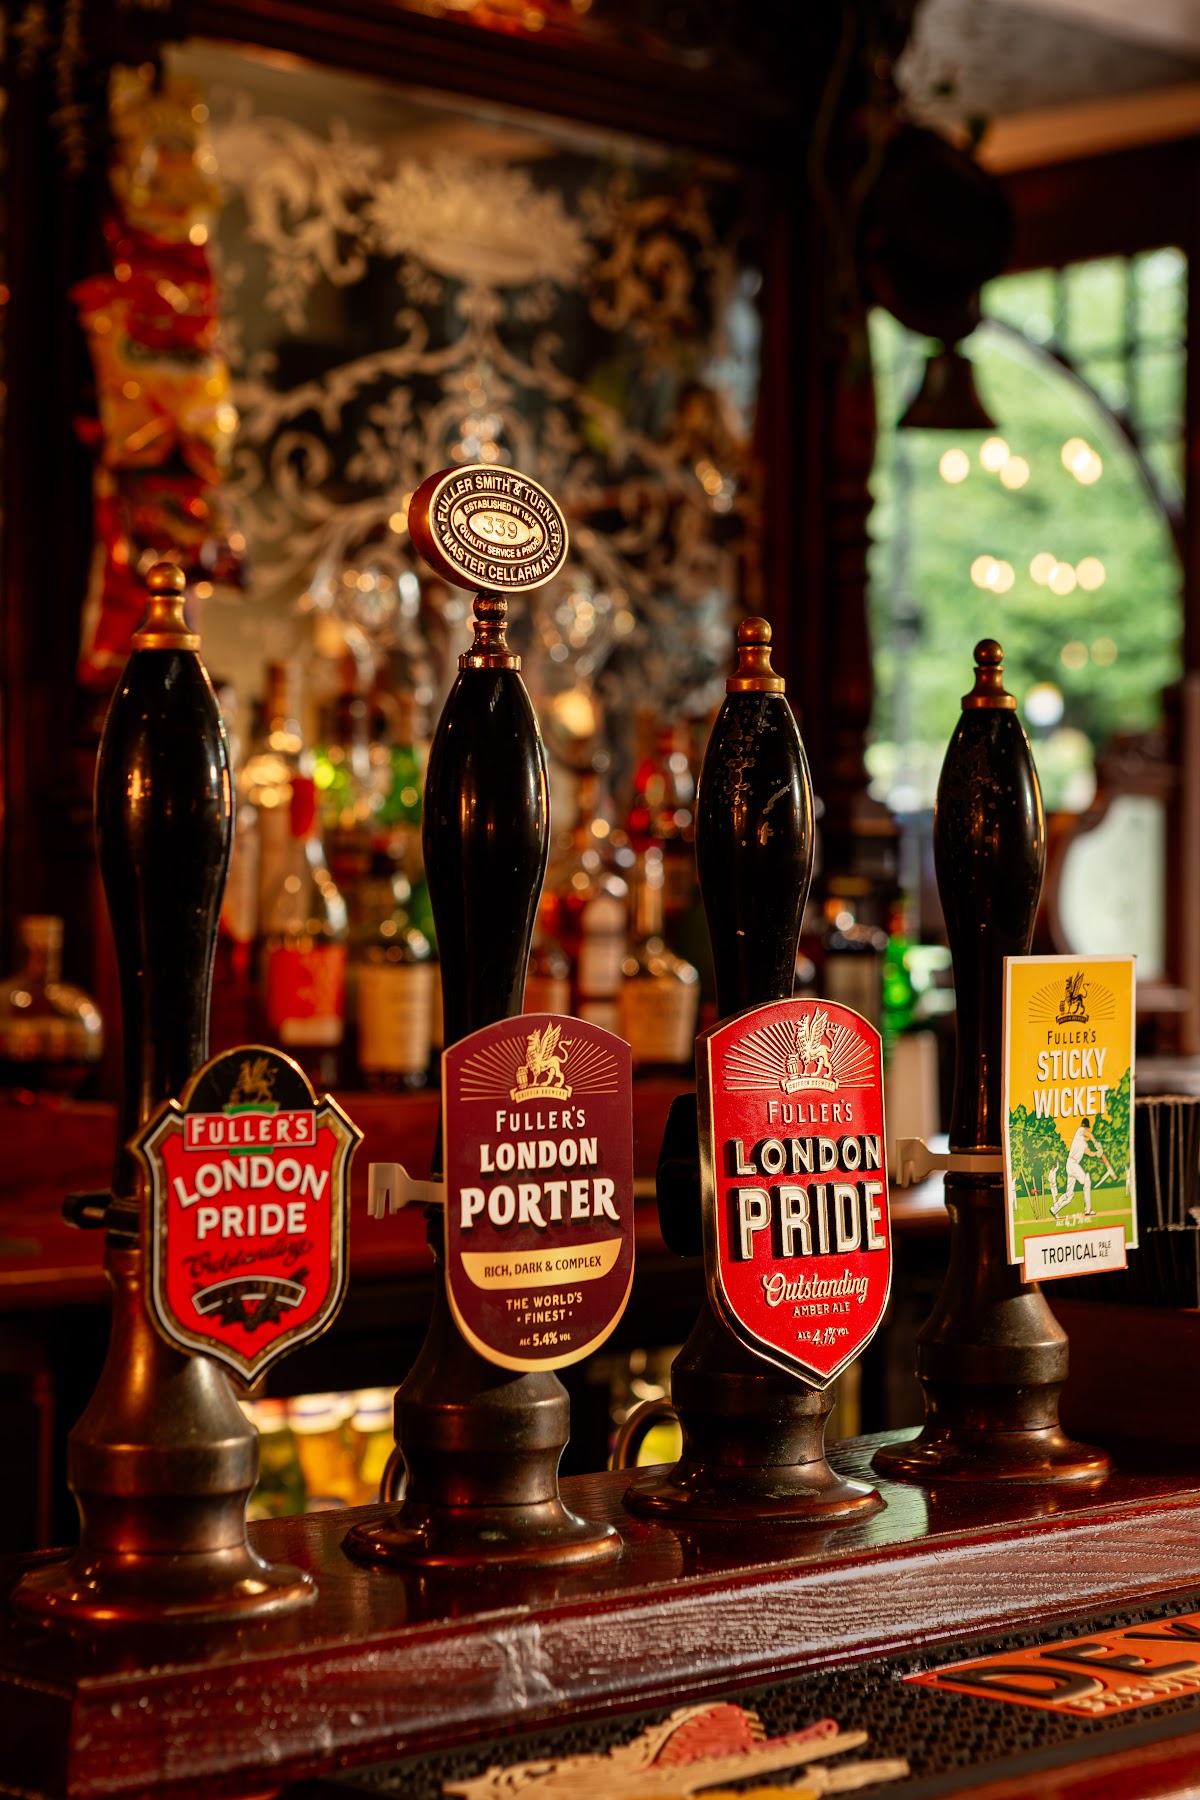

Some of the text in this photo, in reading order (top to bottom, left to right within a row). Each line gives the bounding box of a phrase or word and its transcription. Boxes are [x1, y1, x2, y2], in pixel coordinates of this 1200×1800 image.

[437, 475, 560, 545] FULLER SMITH & TURNER
[464, 500, 536, 528] ESTABLISHED IN 1845
[459, 524, 540, 558] QUALITY SERVICE & PRIDE
[483, 516, 518, 539] 339
[441, 531, 556, 581] MASTER CELLARMAN
[1047, 1028, 1096, 1045] FULLER'S
[1036, 1047, 1107, 1082] STICKY
[768, 1099, 853, 1124] FULLER'S
[1033, 1084, 1110, 1119] WICKET
[191, 1114, 308, 1145] FULLER'S
[496, 1105, 586, 1133] FULLER'S
[479, 1137, 598, 1175] LONDON
[733, 1135, 882, 1176] LONDON
[173, 1156, 329, 1208] LONDON
[460, 1177, 620, 1230] PORTER
[197, 1202, 307, 1240] PRIDE
[737, 1182, 886, 1260] PRIDE
[1042, 1243, 1097, 1264] TROPICAL
[1099, 1240, 1111, 1249] PALE
[1099, 1249, 1108, 1257] ALE
[484, 1256, 601, 1278] RICH, DARK & COMPLEX
[506, 1292, 582, 1311] THE WORLD'S
[762, 1269, 869, 1307] Outstanding
[525, 1309, 565, 1324] FINEST
[793, 1301, 850, 1317] AMBER ALE
[520, 1331, 571, 1347] ALC 5.4% VOL
[797, 1331, 811, 1340] ALC
[836, 1327, 849, 1336] VOL
